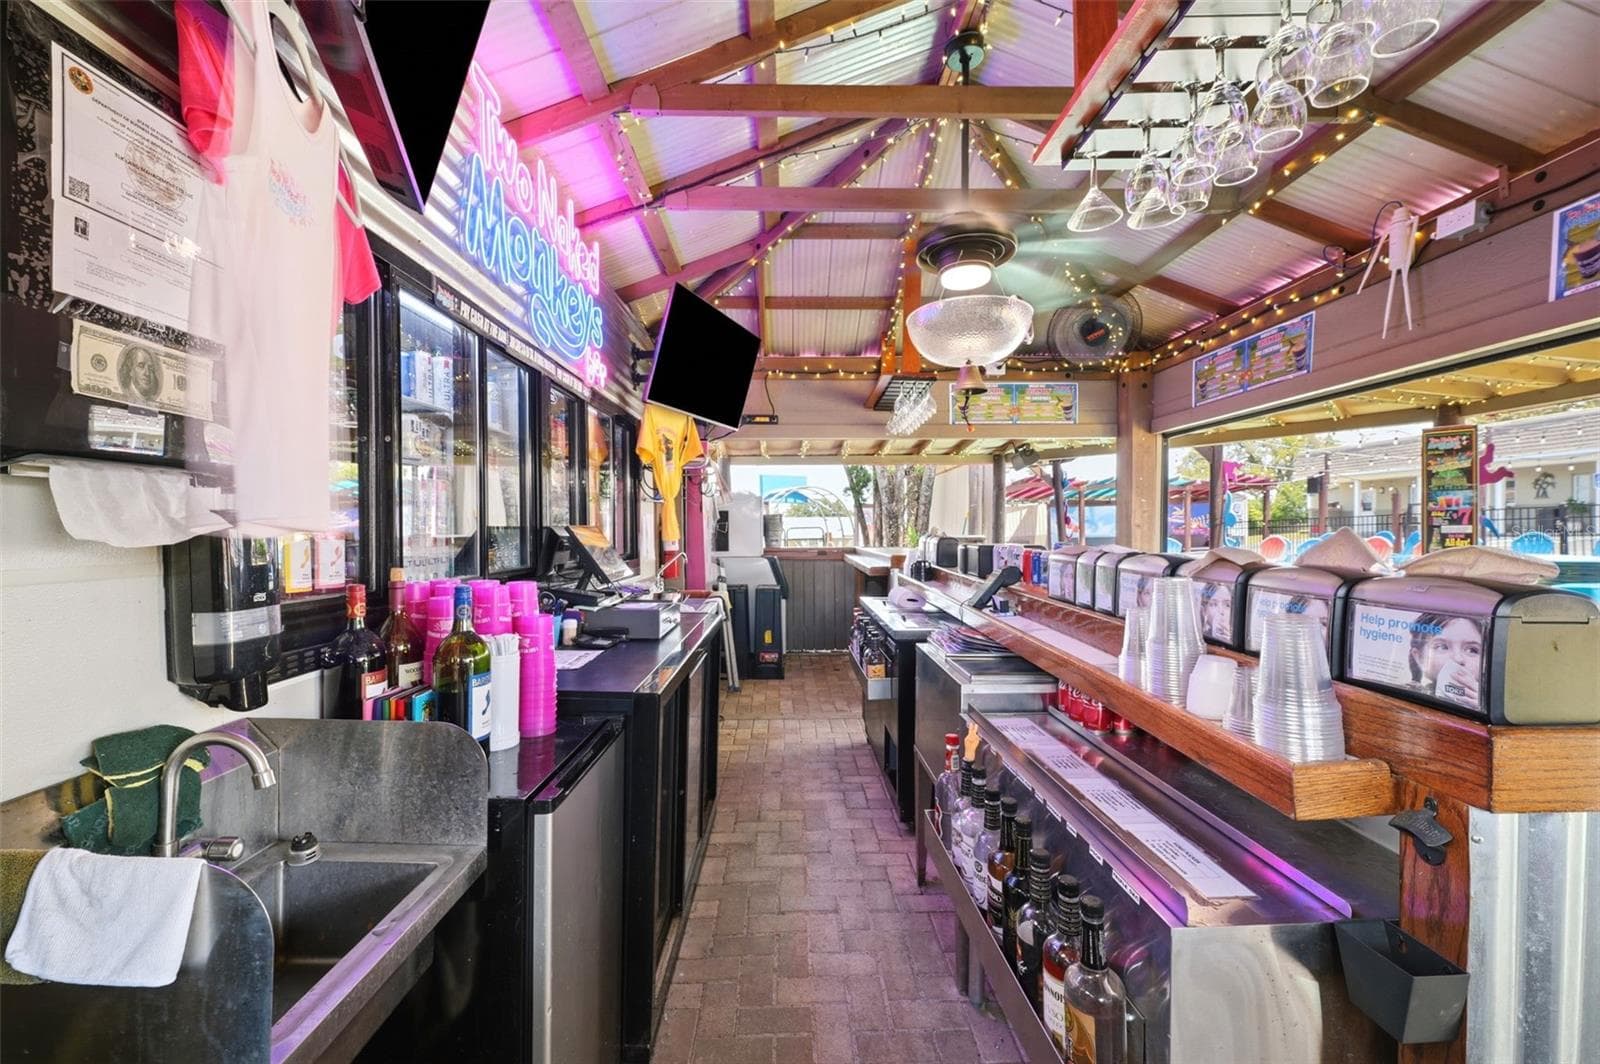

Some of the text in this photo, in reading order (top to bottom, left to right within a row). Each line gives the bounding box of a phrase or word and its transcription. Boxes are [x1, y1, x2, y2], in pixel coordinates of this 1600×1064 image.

[471, 60, 534, 213] Two
[536, 158, 600, 296] Naked
[465, 151, 603, 360] Monkeys
[444, 371, 452, 401] ULTRA
[1359, 625, 1403, 643] hygiene
[1360, 612, 1443, 635] Help promote
